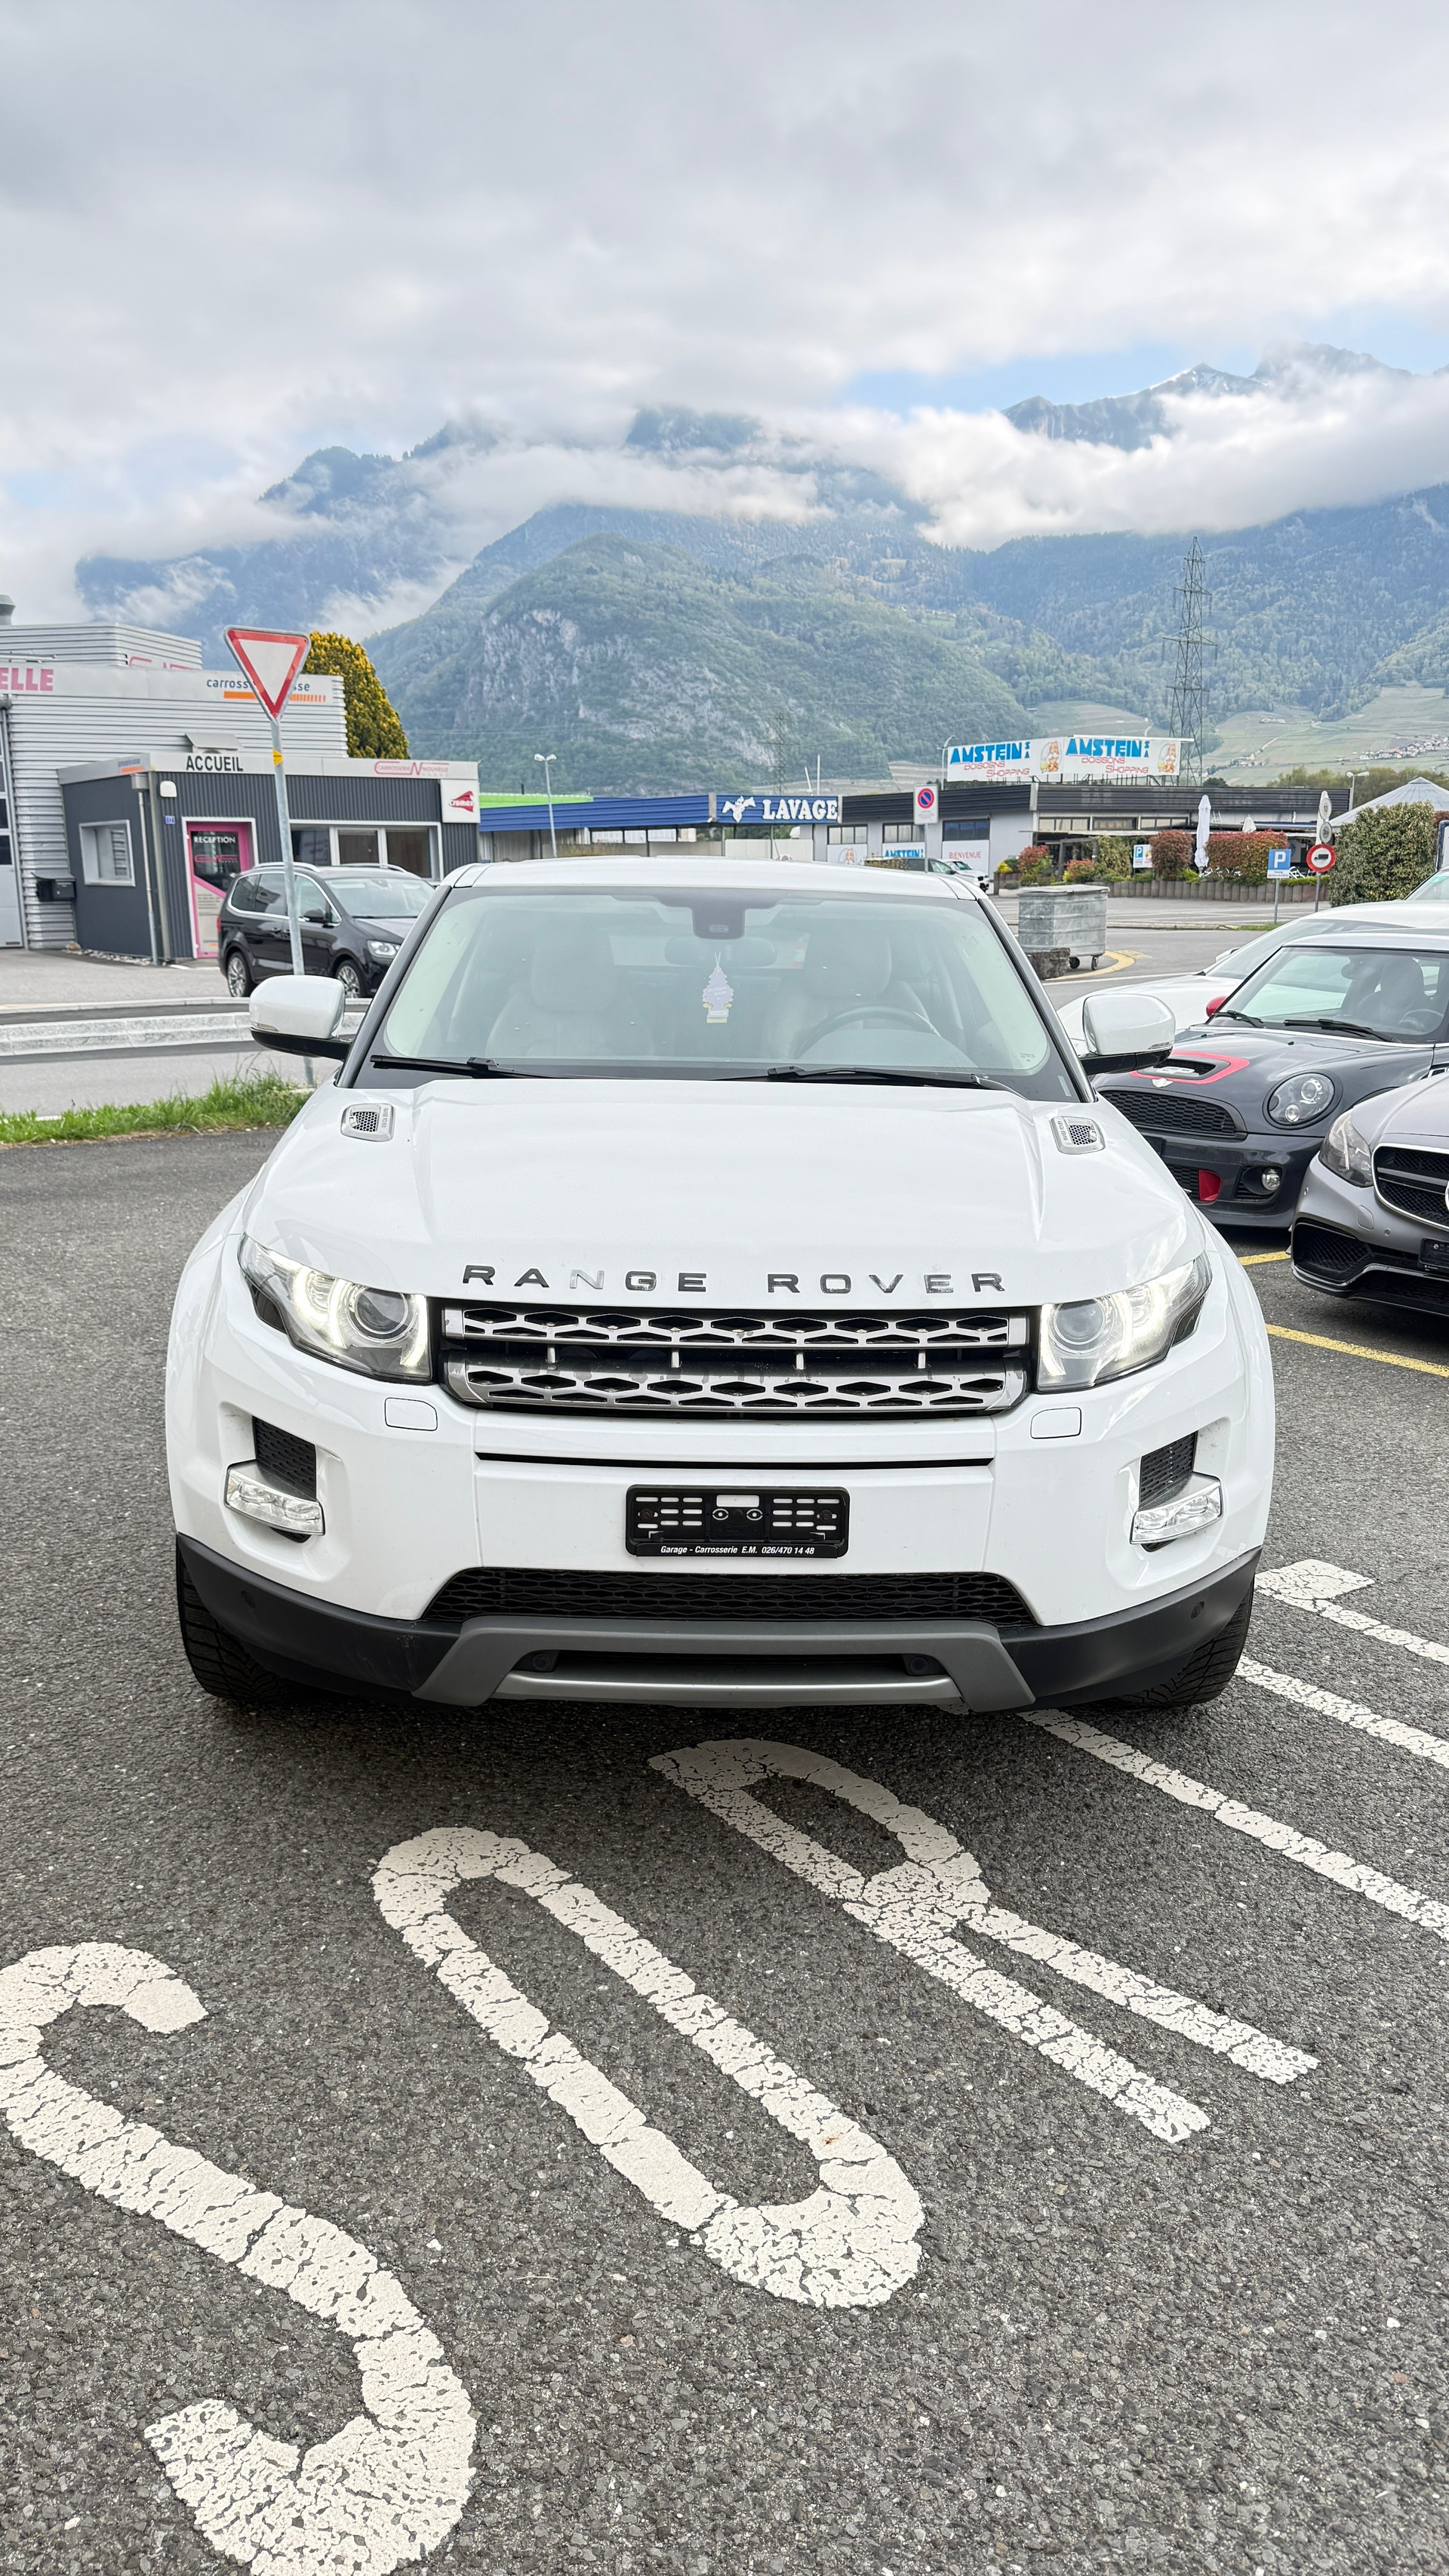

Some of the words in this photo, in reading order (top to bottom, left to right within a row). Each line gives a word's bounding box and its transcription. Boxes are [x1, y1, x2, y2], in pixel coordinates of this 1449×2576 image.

[949, 742, 1023, 765] AMSTEIN
[1066, 738, 1143, 758] AMSTEIN
[186, 755, 244, 772] ACCUEIL
[1081, 756, 1125, 765] BOISSONS
[986, 768, 1030, 778] SHOPPING
[1106, 765, 1149, 774] SHOPPING
[762, 799, 838, 820] LAVAGE
[193, 836, 236, 844] RECEPTION
[949, 851, 981, 860] BIENVENUE
[1273, 851, 1287, 869] P
[462, 1264, 707, 1293] RANGE
[767, 1272, 1008, 1295] ROVER
[660, 1546, 688, 1555] Garage
[694, 1546, 738, 1554] Carrosserie
[741, 1546, 758, 1554] E.M.
[761, 1546, 792, 1555] 026/470
[794, 1547, 803, 1555] 14
[804, 1547, 815, 1555] 48
